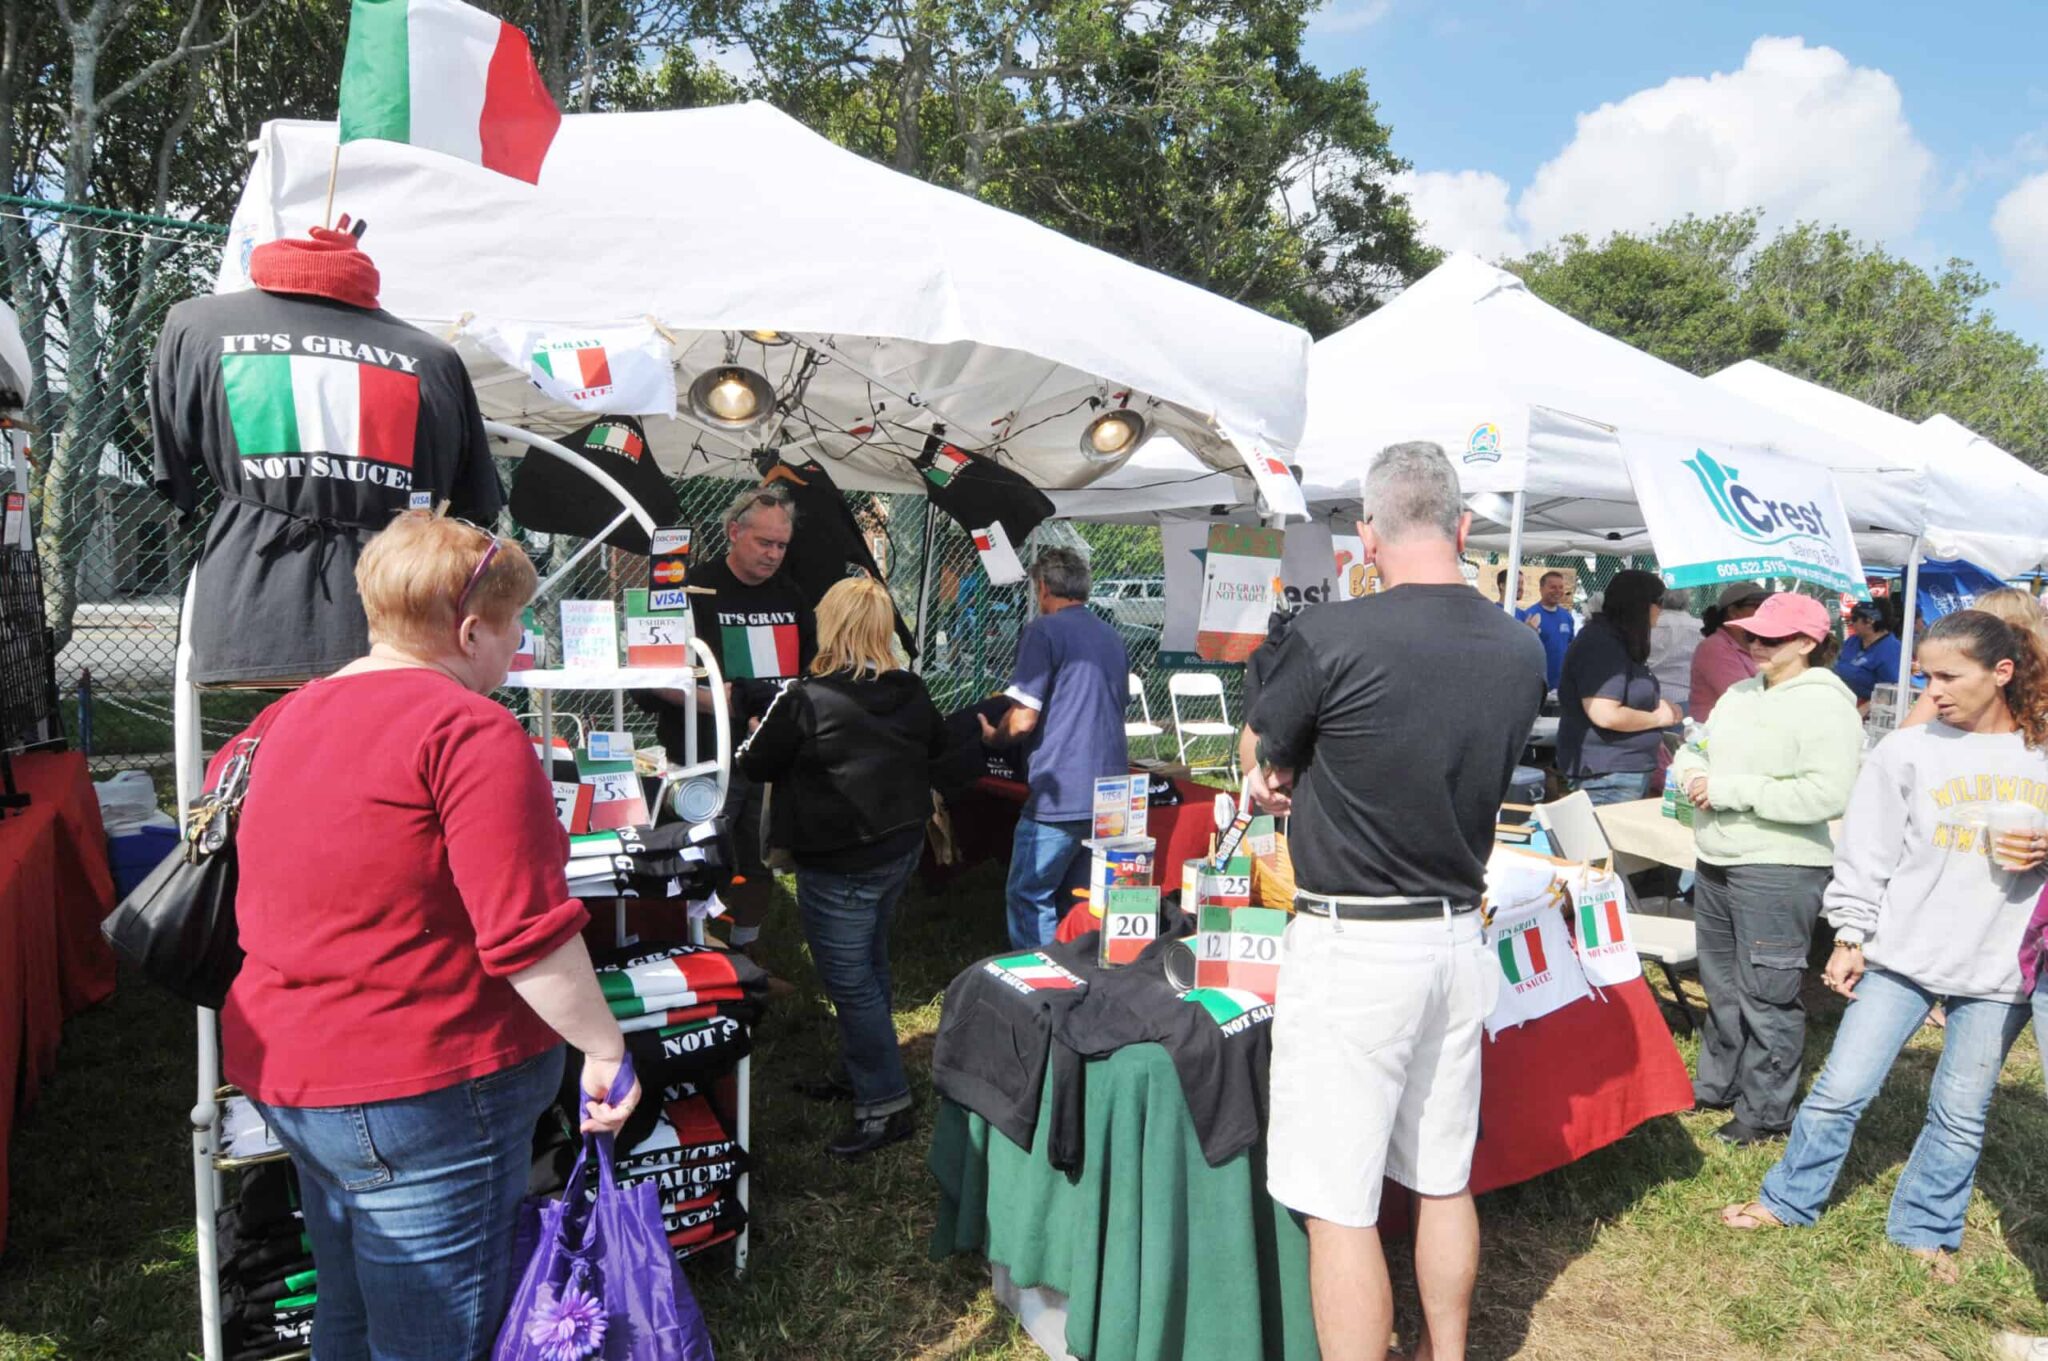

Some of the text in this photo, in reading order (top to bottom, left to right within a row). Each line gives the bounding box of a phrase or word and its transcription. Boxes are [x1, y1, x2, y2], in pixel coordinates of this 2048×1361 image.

[221, 333, 419, 373] IT'S GRAVY
[241, 456, 413, 491] NOT SAUCE!
[411, 496, 430, 505] VISA
[1729, 484, 1832, 540] Crest
[655, 535, 688, 543] DISCOVER
[654, 592, 685, 606] VISA
[718, 612, 797, 625] IT'S GRAVY
[1928, 773, 2048, 814] WILDWOO
[1223, 877, 1250, 895] 25
[1116, 915, 1149, 937] 20
[1205, 934, 1222, 959] 12
[1238, 935, 1278, 961] 20
[1219, 1010, 1251, 1038] NOT
[661, 1027, 716, 1059] NOT
[642, 1161, 736, 1191] AUCE!
[663, 1199, 725, 1232] UCE!
